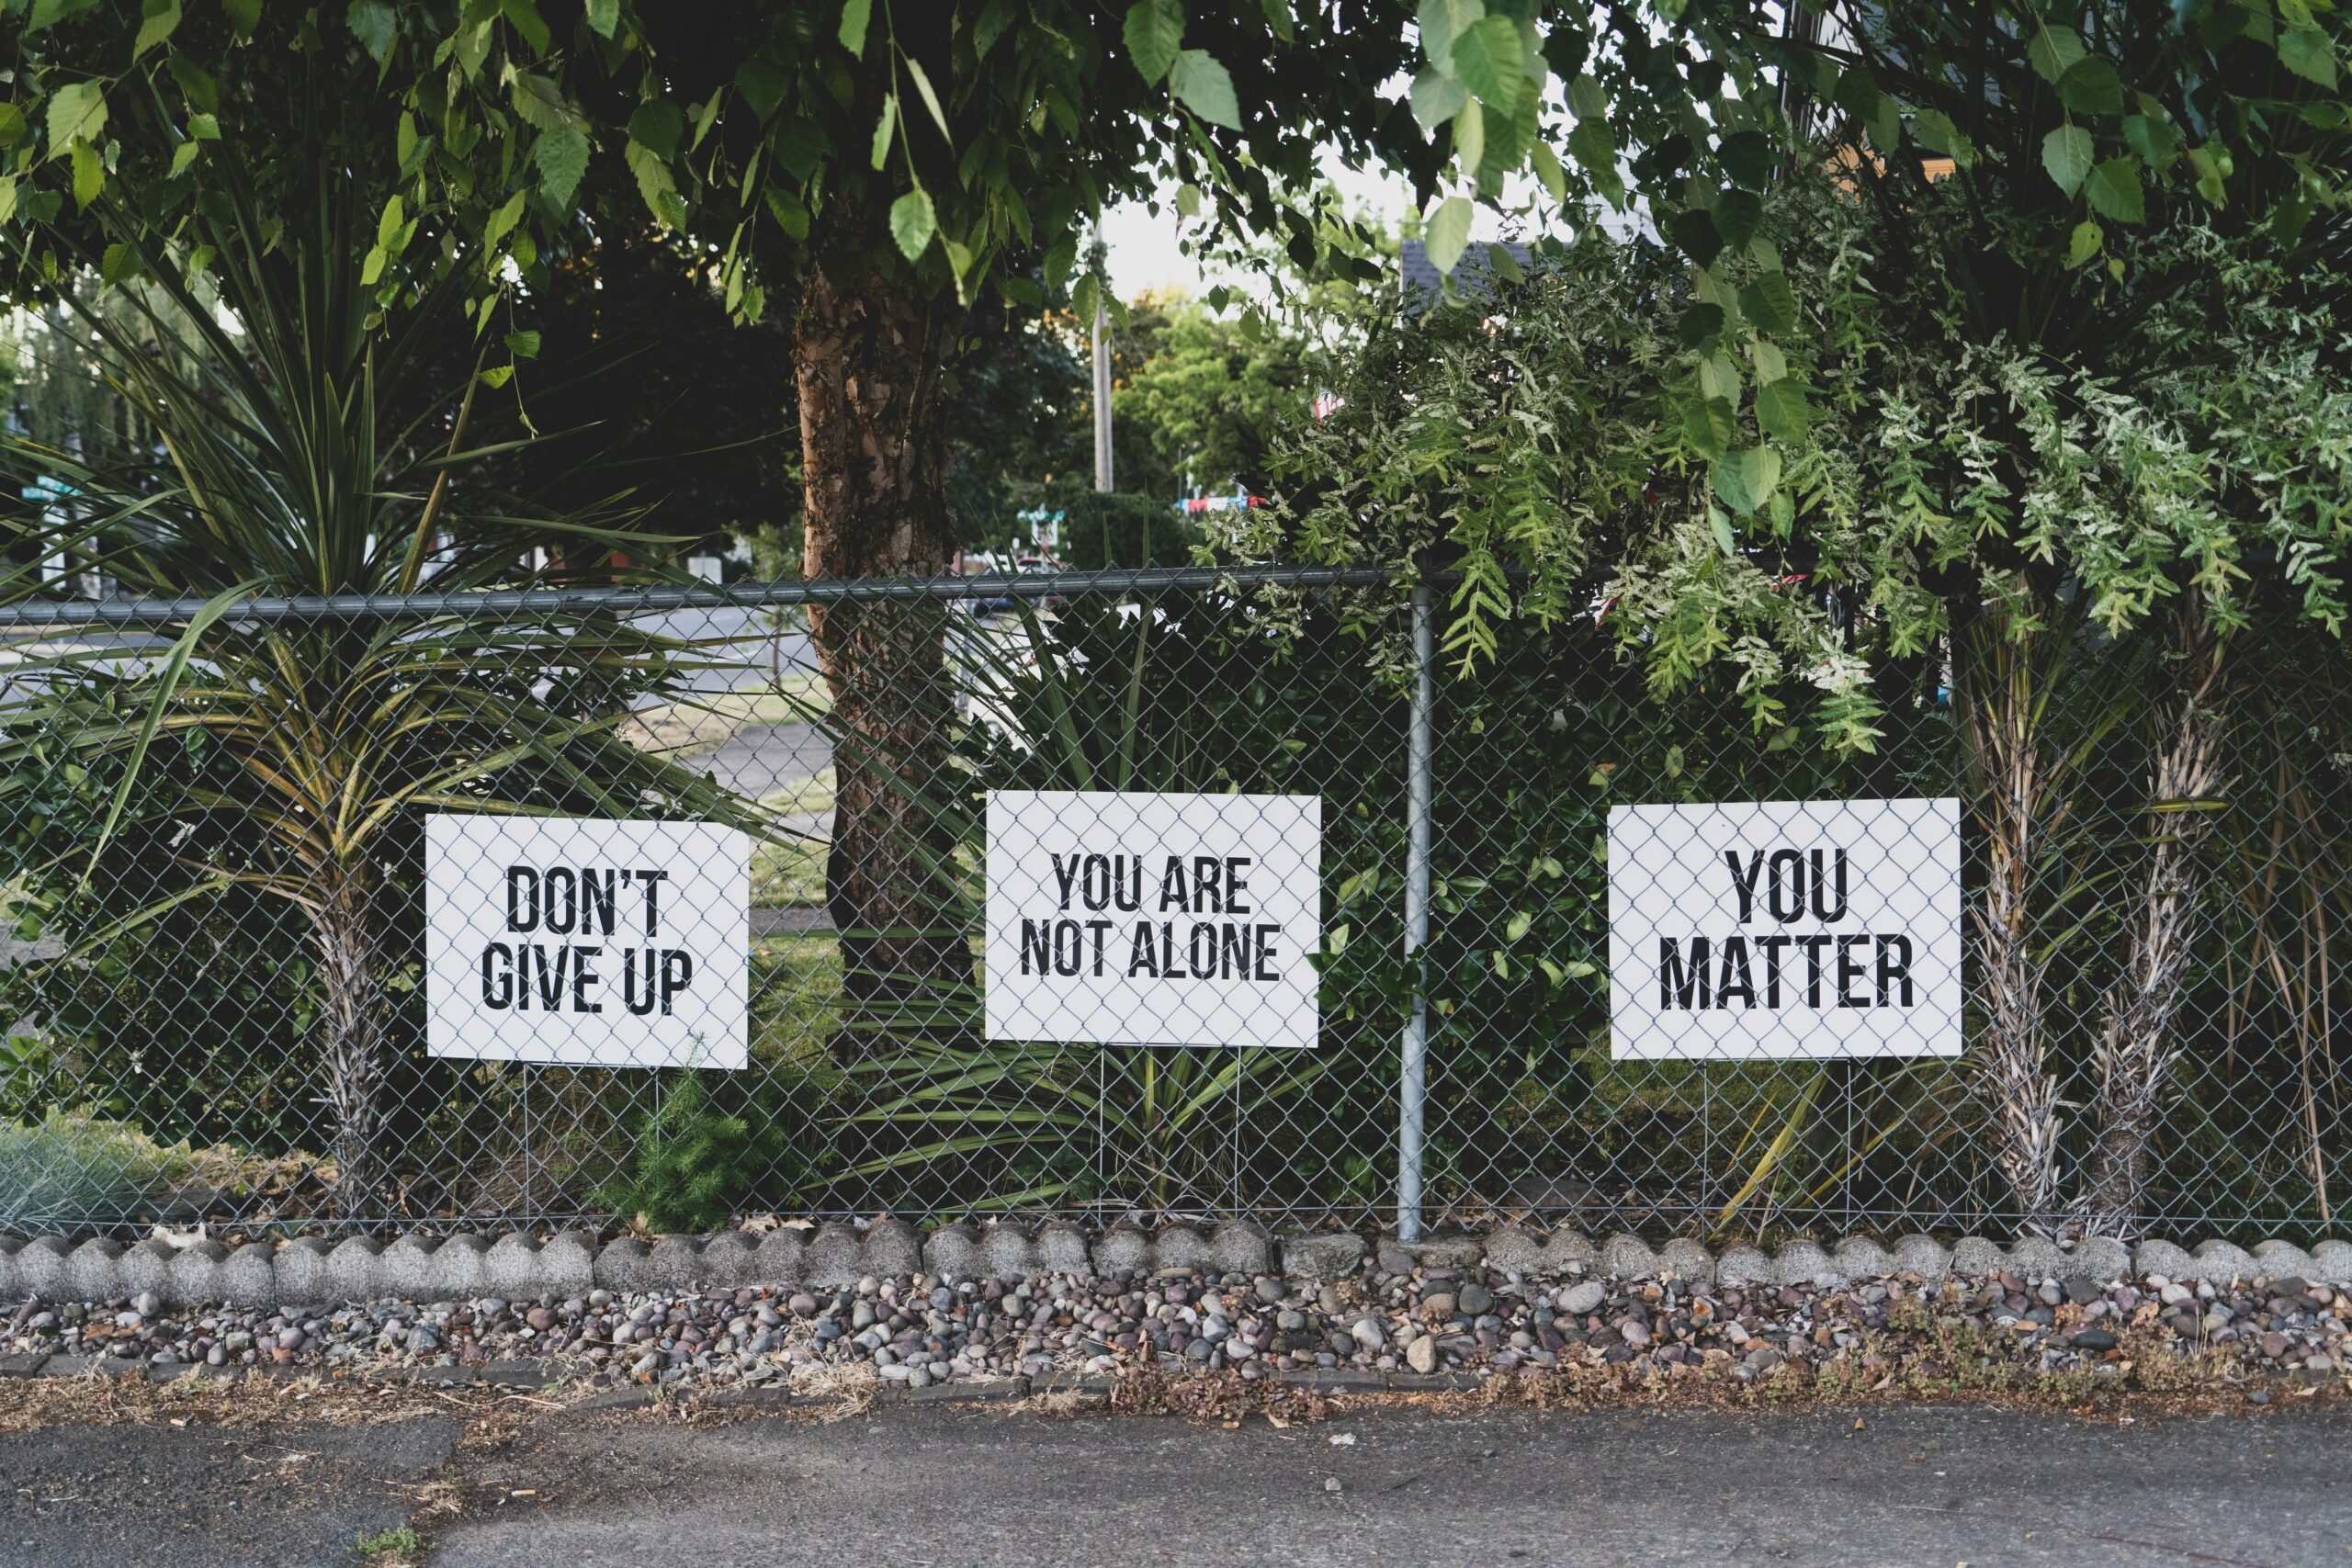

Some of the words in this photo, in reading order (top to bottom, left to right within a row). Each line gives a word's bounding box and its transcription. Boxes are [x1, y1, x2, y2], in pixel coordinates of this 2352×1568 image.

[508, 865, 669, 938] DON'T
[1050, 852, 1142, 912] YOU
[1159, 855, 1251, 914] ARE
[1724, 848, 1848, 924] YOU
[481, 942, 603, 1014] GIVE
[624, 947, 693, 1016] UP
[1020, 919, 1113, 977] NOT
[1127, 920, 1281, 982] ALONE
[1659, 933, 1914, 1010] MATTER
